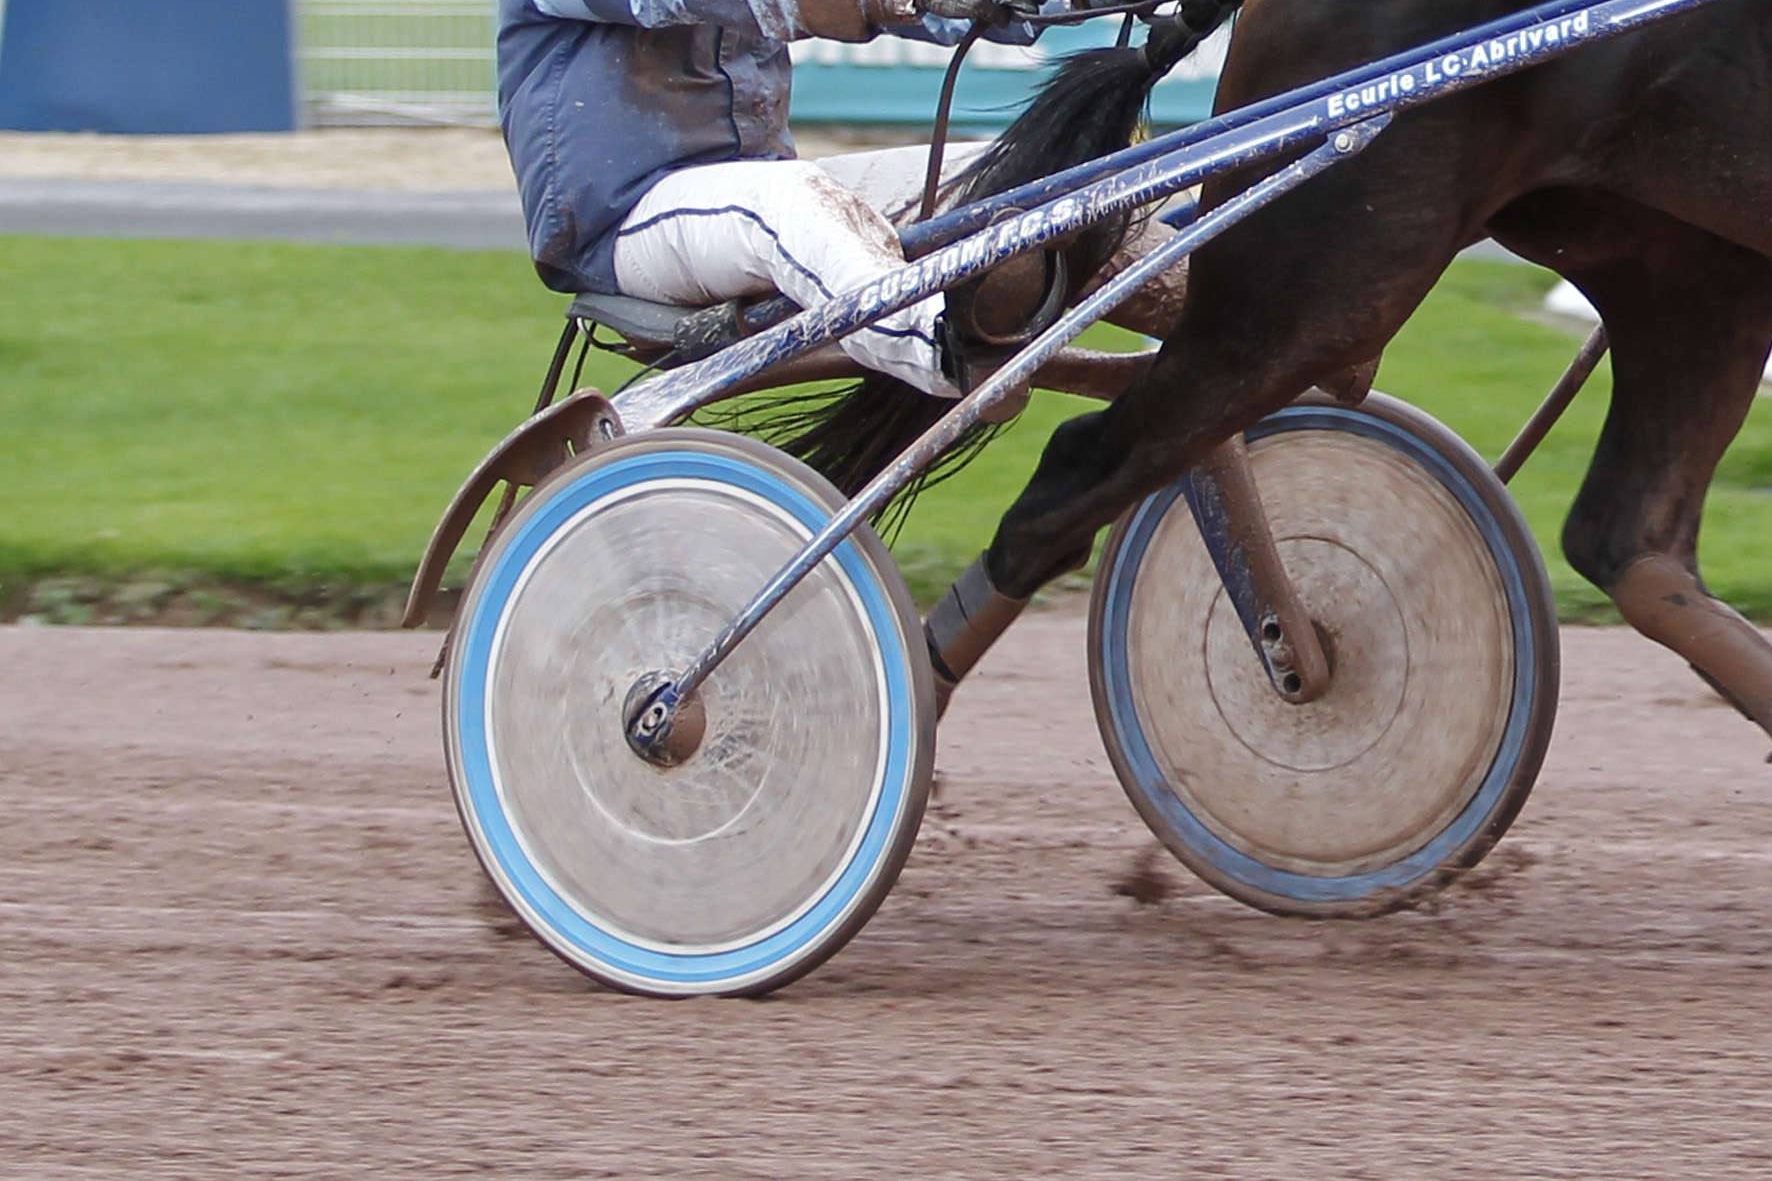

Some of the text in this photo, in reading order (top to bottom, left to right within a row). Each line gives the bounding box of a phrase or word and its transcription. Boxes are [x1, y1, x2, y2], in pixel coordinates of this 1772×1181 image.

[1327, 72, 1415, 118] Ecurie
[1470, 10, 1590, 68] Abrivard
[858, 233, 988, 311] CUSTOM
